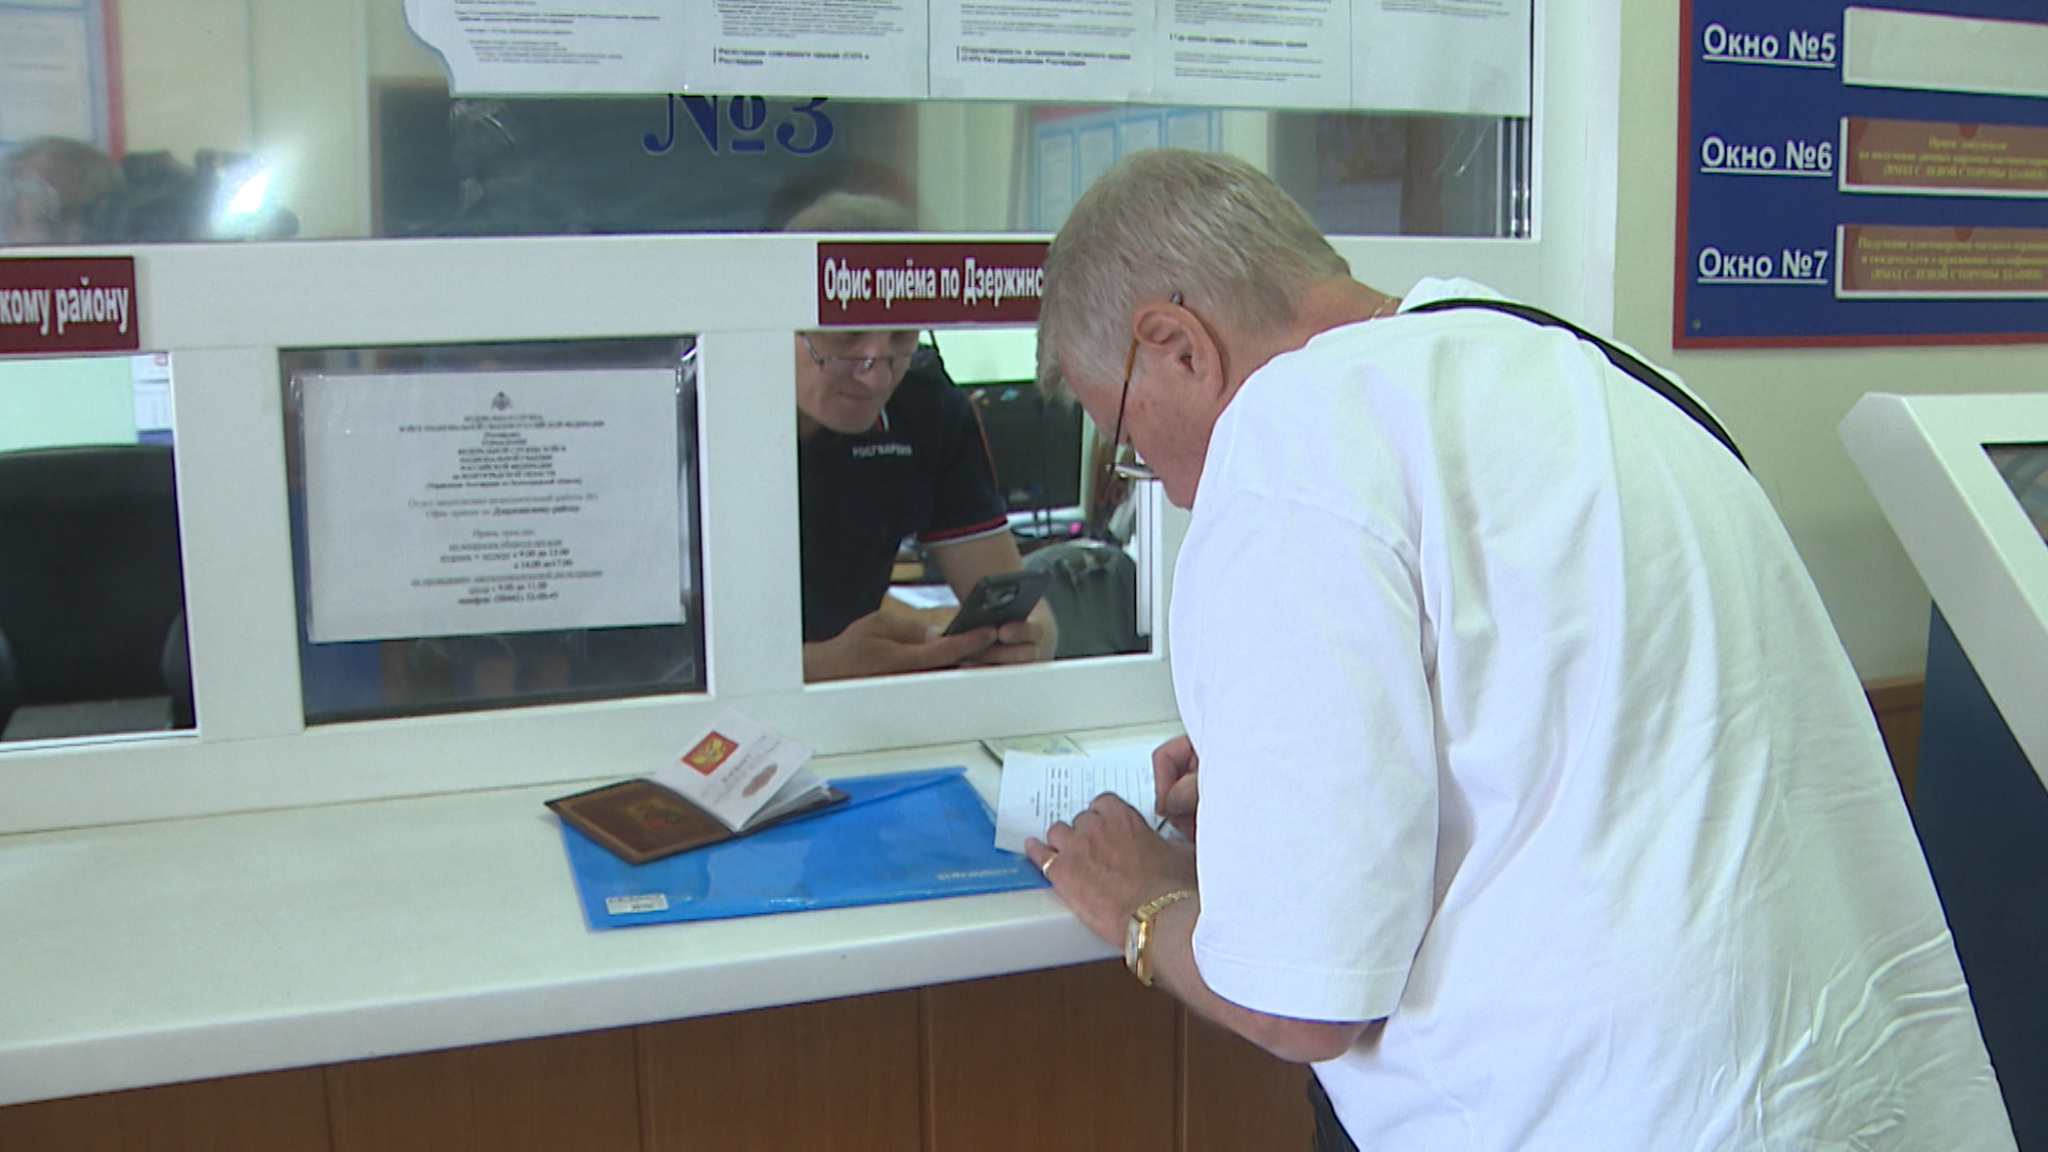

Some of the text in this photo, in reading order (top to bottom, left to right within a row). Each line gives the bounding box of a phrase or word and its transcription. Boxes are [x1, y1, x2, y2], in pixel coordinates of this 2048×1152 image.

[1703, 23, 1836, 62] Окно №5
[642, 95, 834, 153] №3
[1702, 136, 1776, 168] Окно
[1786, 140, 1833, 170] №6
[824, 258, 872, 311] Офис
[875, 259, 937, 309] приёма
[940, 269, 960, 299] по
[1699, 247, 1773, 277] Окно
[1782, 249, 1828, 278] №7
[55, 276, 129, 334] району
